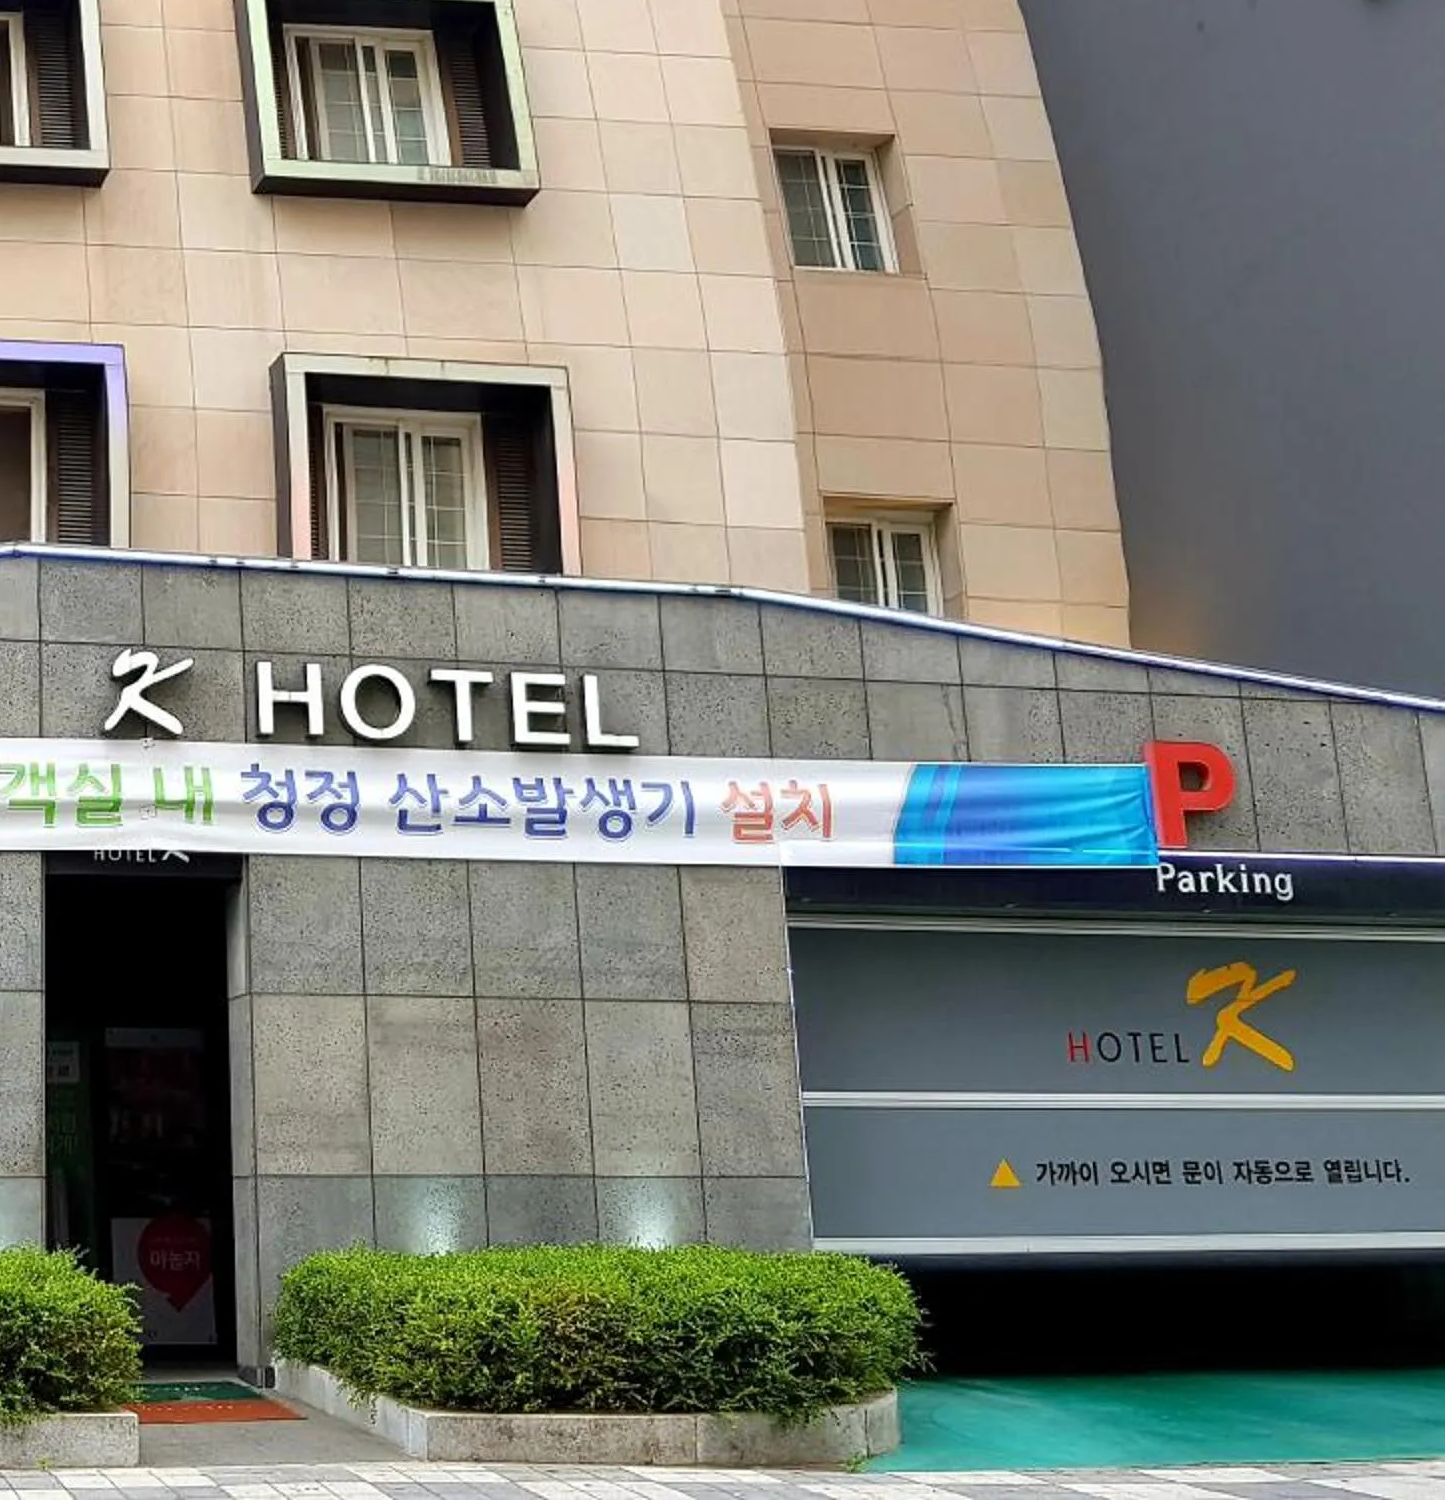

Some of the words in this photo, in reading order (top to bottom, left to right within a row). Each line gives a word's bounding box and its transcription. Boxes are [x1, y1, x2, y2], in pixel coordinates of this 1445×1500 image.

[104, 649, 193, 735] K
[254, 660, 640, 752] HOTEL
[153, 758, 214, 828] 내
[240, 762, 357, 835] 청정
[389, 768, 697, 842] 산소발생기
[719, 778, 835, 845] 설치
[1143, 741, 1235, 849] P
[1157, 865, 1295, 900] Parking
[1068, 1032, 1190, 1063] HOTEL
[1186, 961, 1297, 1071] K
[1036, 1160, 1099, 1186] 가까이
[1110, 1160, 1172, 1186] 오시면
[1183, 1160, 1222, 1186] 문이
[1233, 1160, 1312, 1186] 자동으로
[1325, 1160, 1410, 1186] 열립니다.
